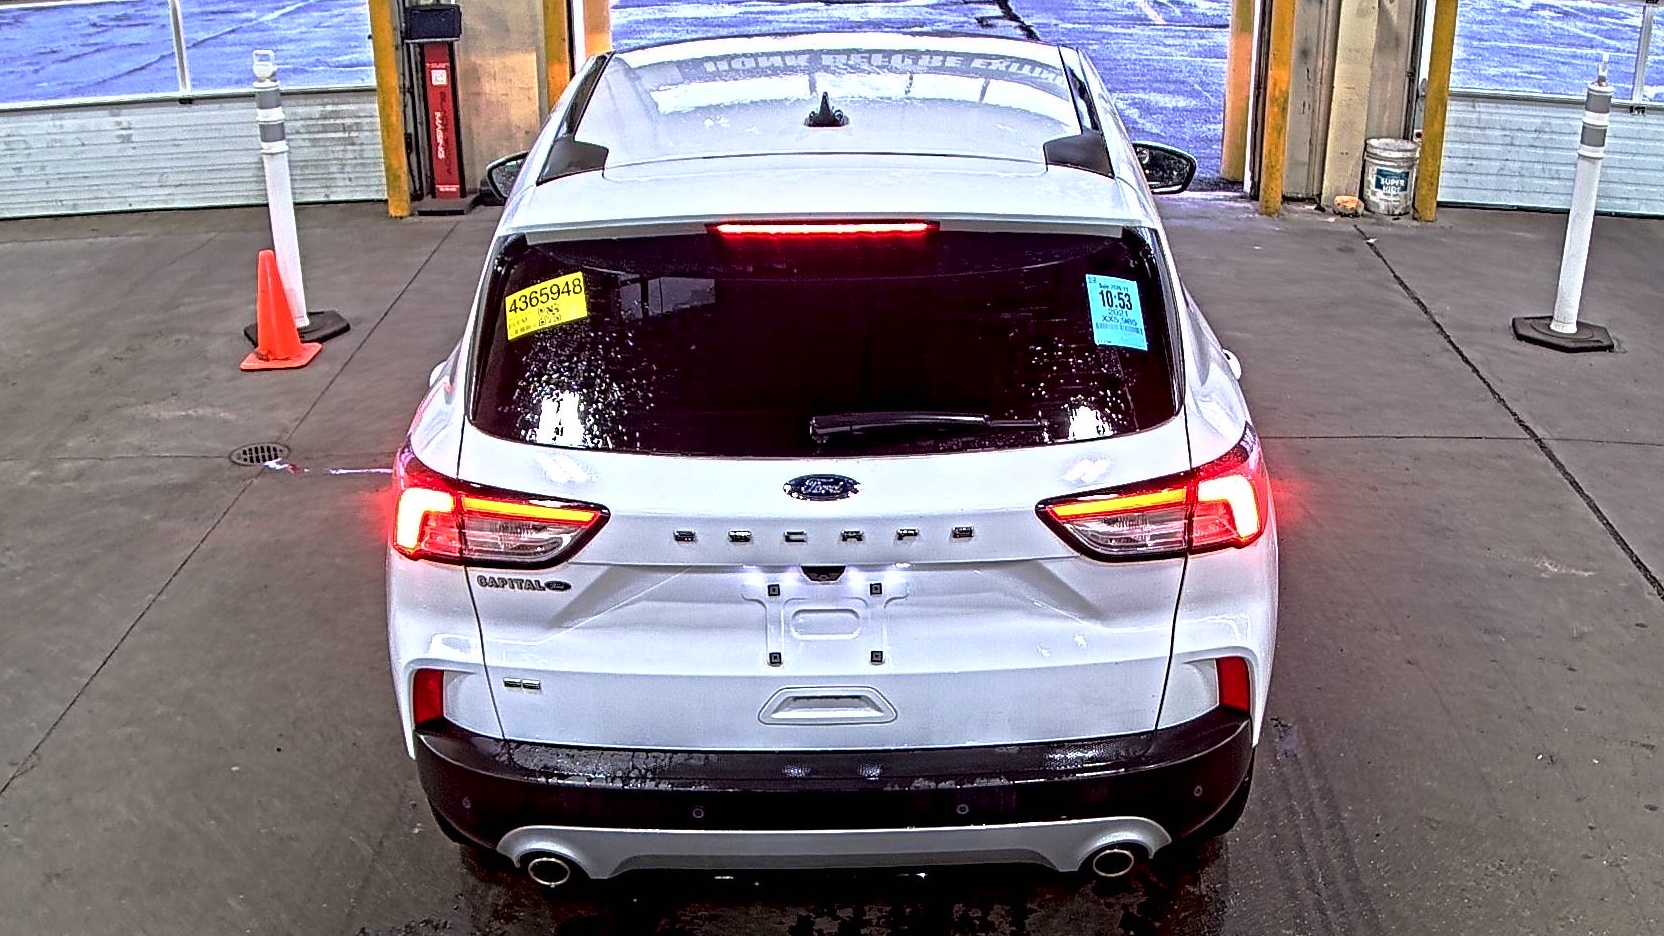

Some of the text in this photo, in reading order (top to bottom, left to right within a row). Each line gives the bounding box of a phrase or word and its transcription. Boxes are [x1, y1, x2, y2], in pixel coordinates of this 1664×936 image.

[508, 278, 583, 314] 4365948
[1099, 289, 1133, 311] 10:53
[673, 526, 975, 543] ESCAPE
[476, 574, 546, 592] CAPITAL
